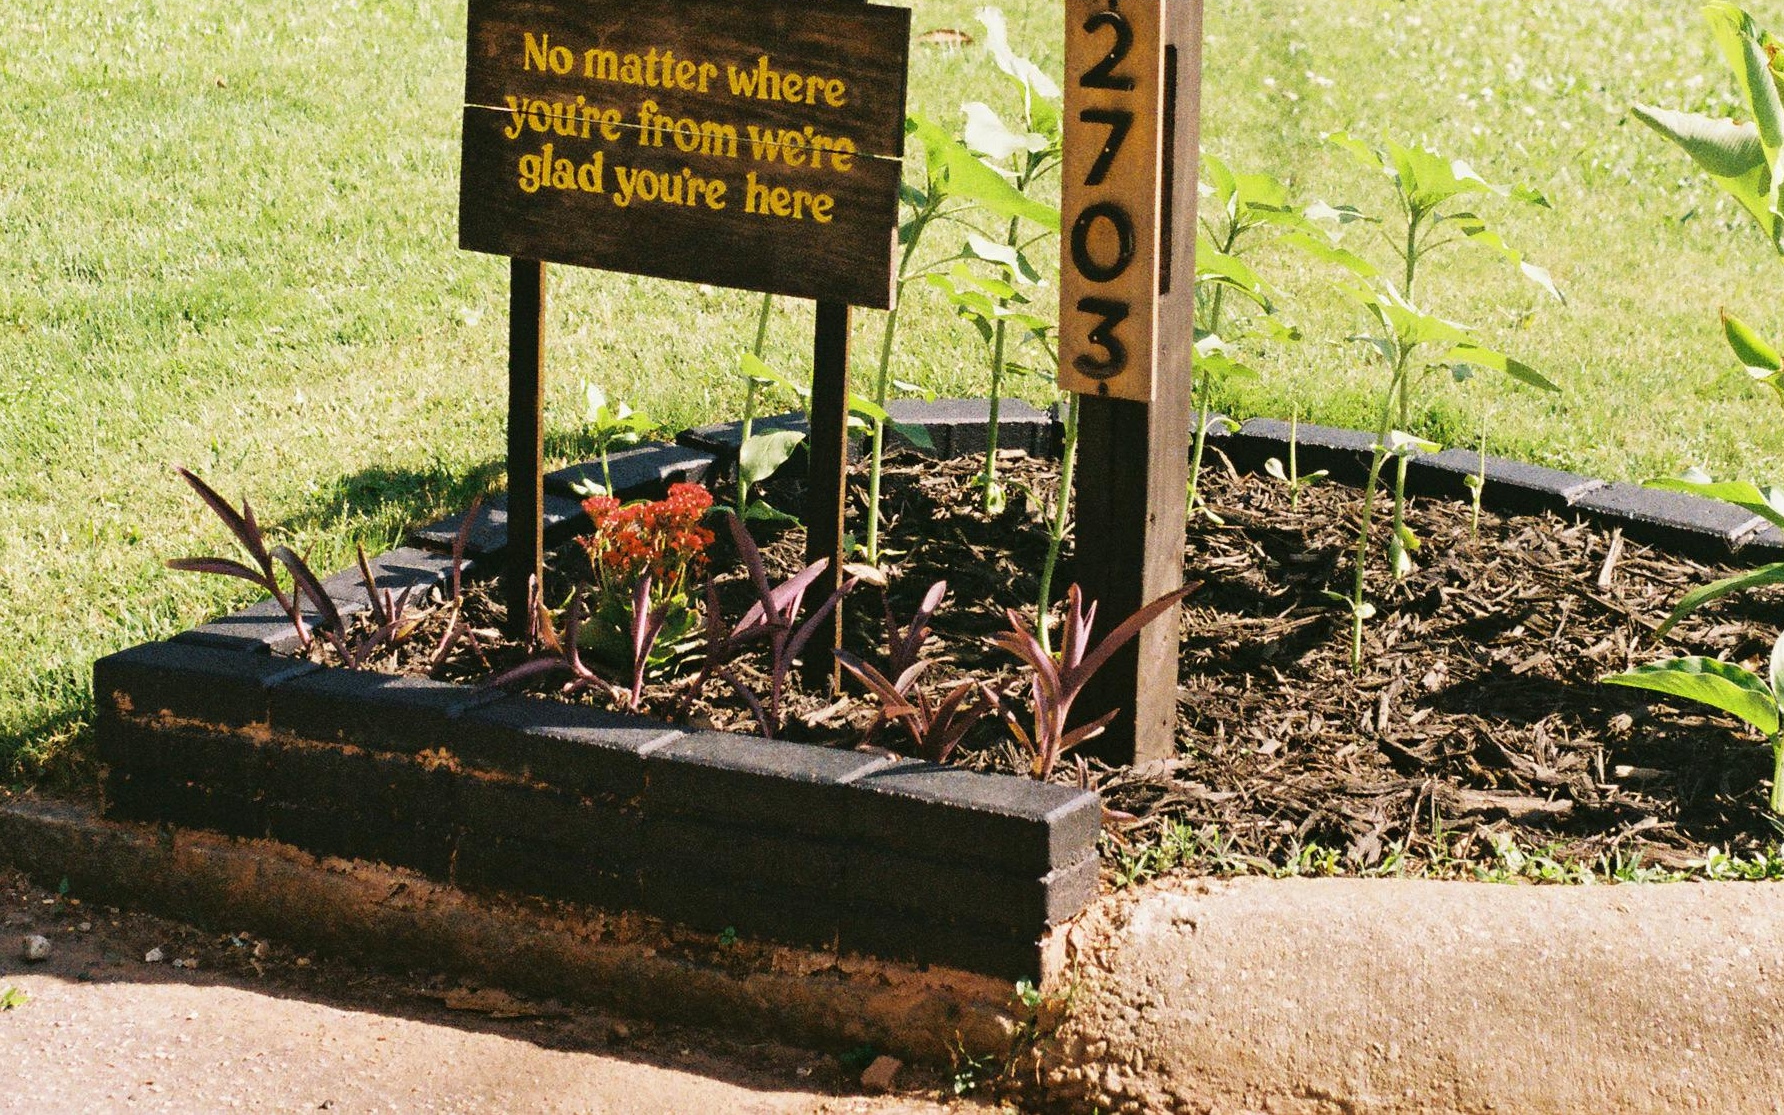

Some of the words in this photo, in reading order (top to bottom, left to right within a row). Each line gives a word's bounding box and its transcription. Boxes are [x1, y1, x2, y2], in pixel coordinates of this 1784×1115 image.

[523, 32, 575, 75] No
[583, 47, 718, 94] matter
[727, 56, 846, 107] where
[504, 94, 622, 140] you're
[638, 99, 738, 158] from
[747, 124, 857, 172] we're
[518, 143, 604, 193] glad
[613, 165, 727, 210] you're
[745, 171, 835, 223] here
[1070, 11, 1135, 379] 2703
